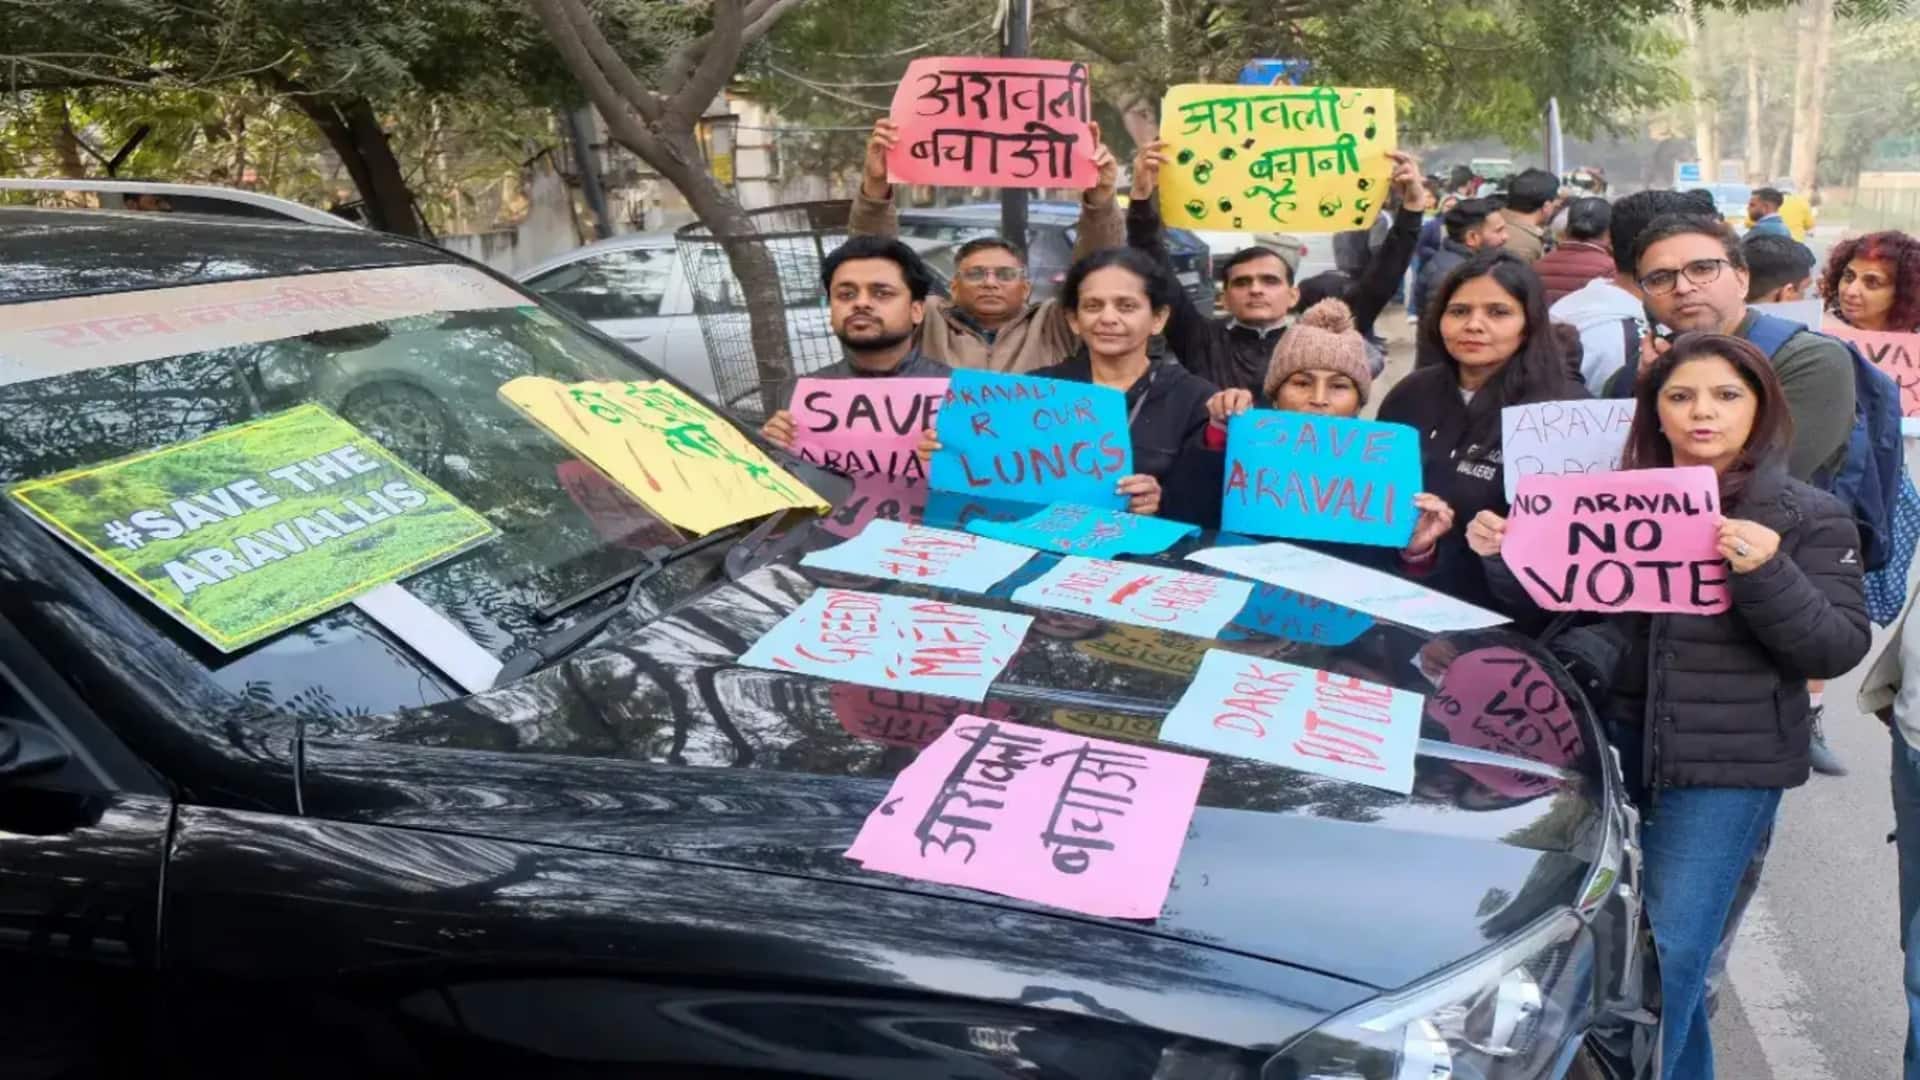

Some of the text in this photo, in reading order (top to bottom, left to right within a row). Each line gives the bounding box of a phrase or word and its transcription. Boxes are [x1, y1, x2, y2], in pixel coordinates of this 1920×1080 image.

[917, 63, 1088, 123] अरावली
[911, 121, 1079, 178] बचाओ
[1033, 397, 1099, 430] OUR
[1250, 417, 1397, 464] SAVE
[959, 432, 1126, 487] LUNGS
[104, 444, 381, 550] #SAVE THE
[1225, 458, 1396, 525] ARAVALI
[1512, 490, 1715, 516] NO ARAVALI
[162, 481, 428, 594] ARAVALLIS
[1568, 519, 1663, 556] NO
[1523, 559, 1727, 606] VOTE
[794, 590, 883, 664] GREEDY
[1212, 663, 1302, 739] DARK
[1292, 670, 1393, 773] FUTURE
